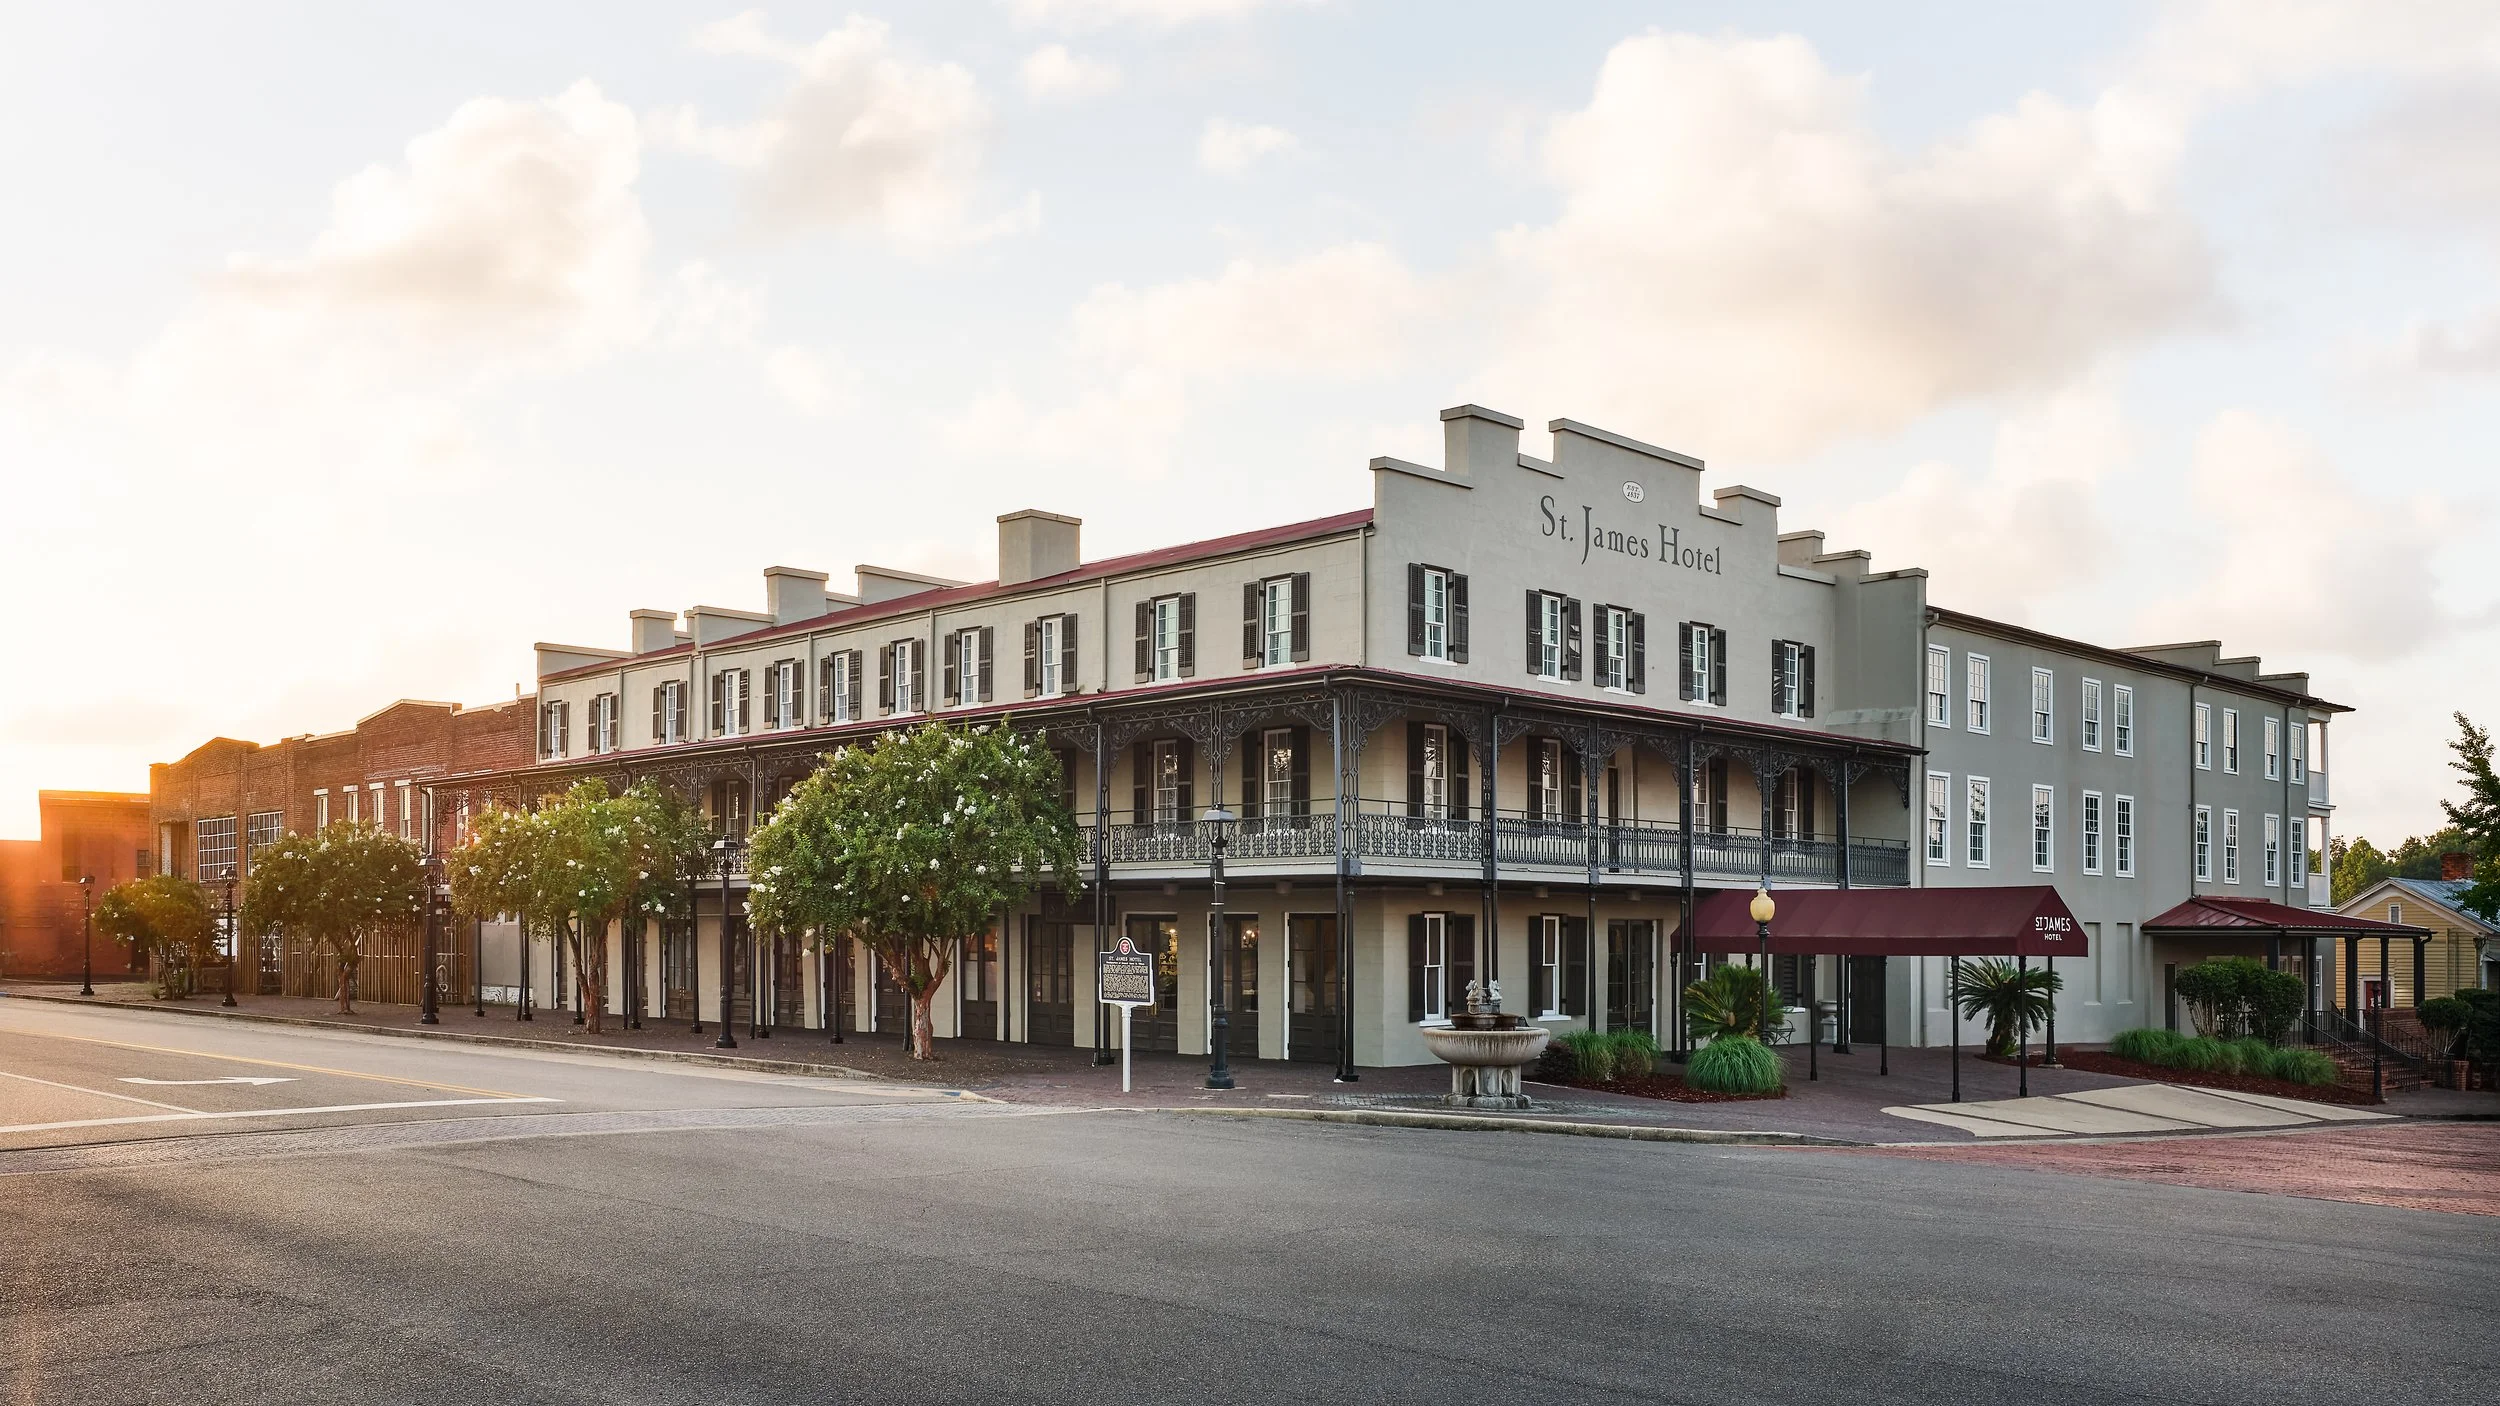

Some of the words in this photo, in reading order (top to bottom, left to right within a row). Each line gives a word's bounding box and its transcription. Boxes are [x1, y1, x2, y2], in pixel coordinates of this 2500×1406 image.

[1540, 495, 1574, 542] St.
[1581, 505, 1649, 565] James
[1658, 523, 1721, 576] Hotel
[2035, 916, 2044, 928] ST
[2044, 916, 2071, 931] JAMES
[2044, 933, 2062, 941] HOTEL
